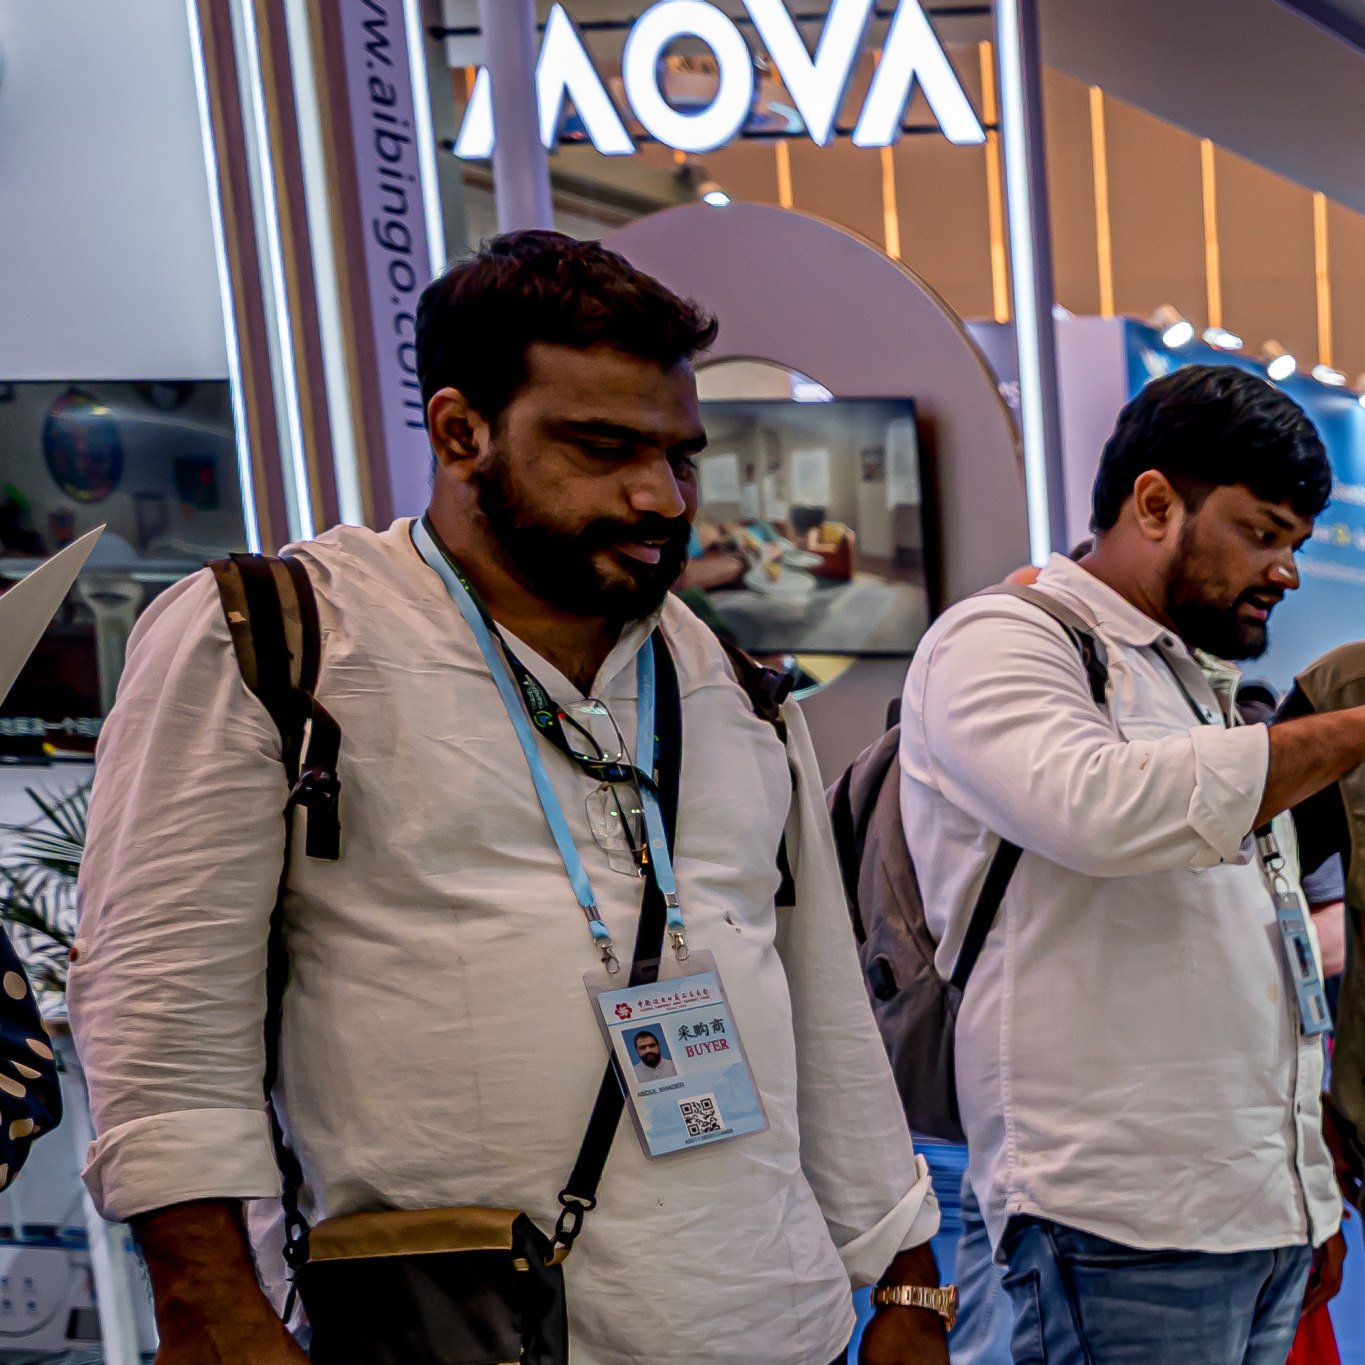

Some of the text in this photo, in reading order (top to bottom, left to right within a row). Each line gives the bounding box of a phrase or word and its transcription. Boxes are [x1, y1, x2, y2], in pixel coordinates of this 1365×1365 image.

[453, 0, 988, 157] MOVA
[361, 0, 425, 430] w.aibingo.com
[677, 1018, 725, 1042] 采购商
[685, 1038, 730, 1058] BUYER
